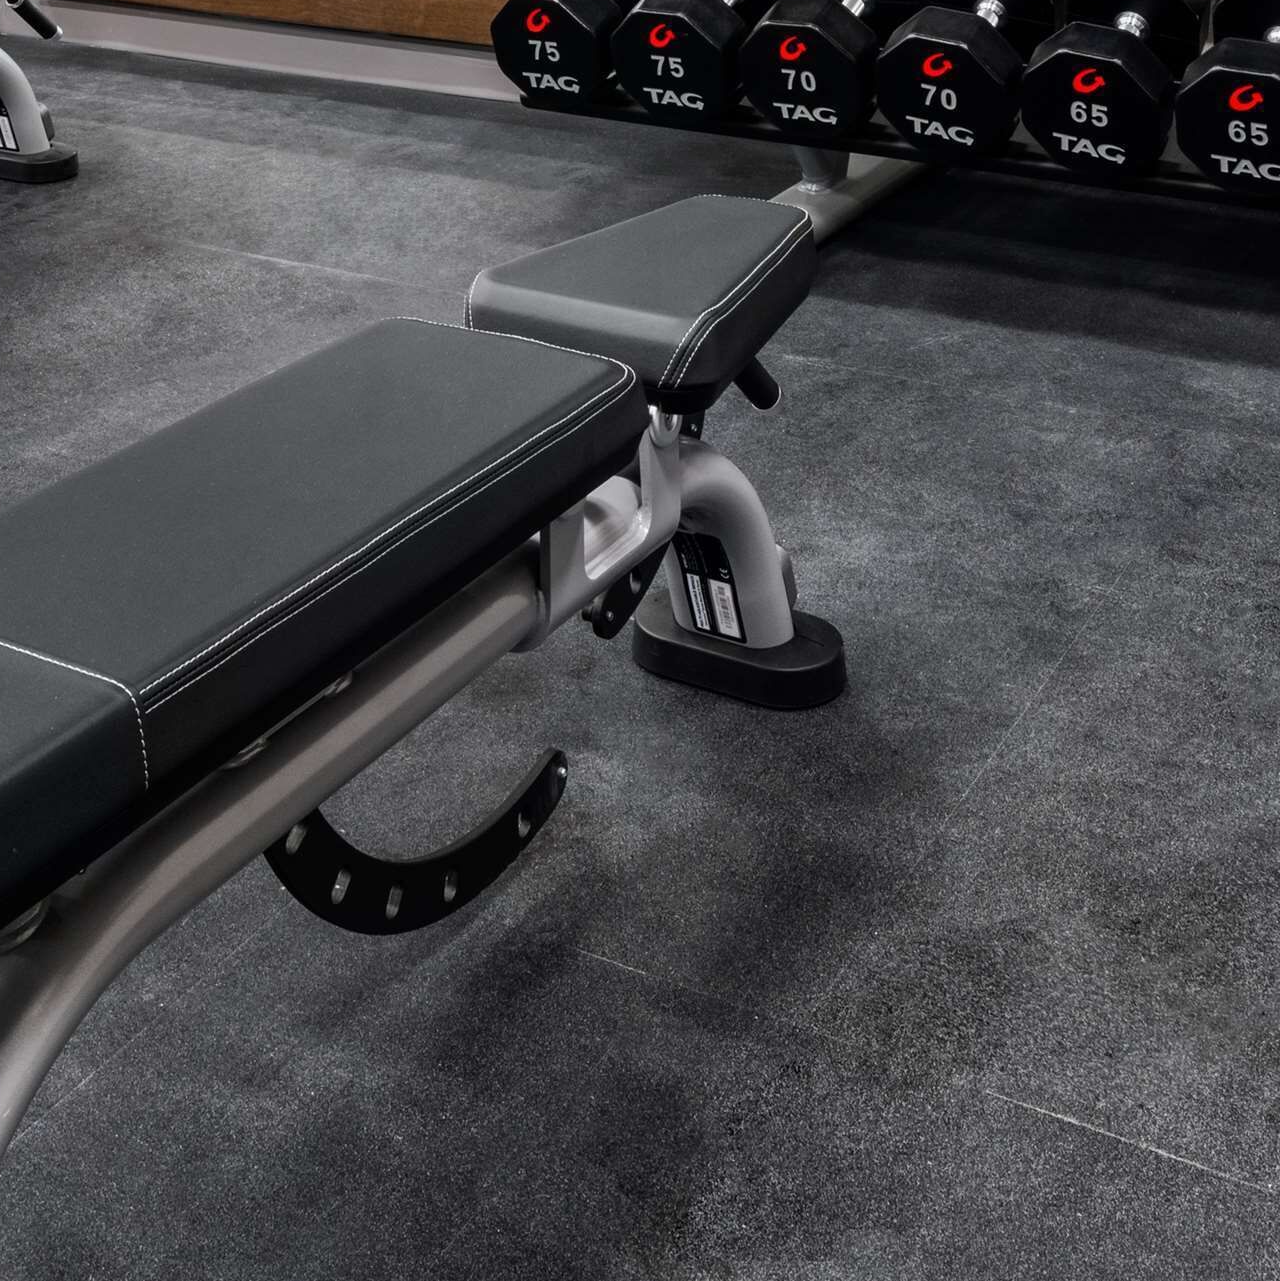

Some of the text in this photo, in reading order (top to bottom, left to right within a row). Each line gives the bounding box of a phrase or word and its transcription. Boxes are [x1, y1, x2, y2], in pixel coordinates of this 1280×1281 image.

[528, 39, 560, 62] 75
[650, 55, 684, 78] 75
[522, 71, 580, 94] TAG
[781, 68, 816, 92] 70
[643, 87, 704, 111] TAG
[920, 83, 957, 110] 70
[773, 102, 838, 125] TAG
[1070, 101, 1108, 127] 65
[905, 115, 974, 146] TAG
[1228, 120, 1269, 146] 65
[1052, 132, 1126, 164] TAG
